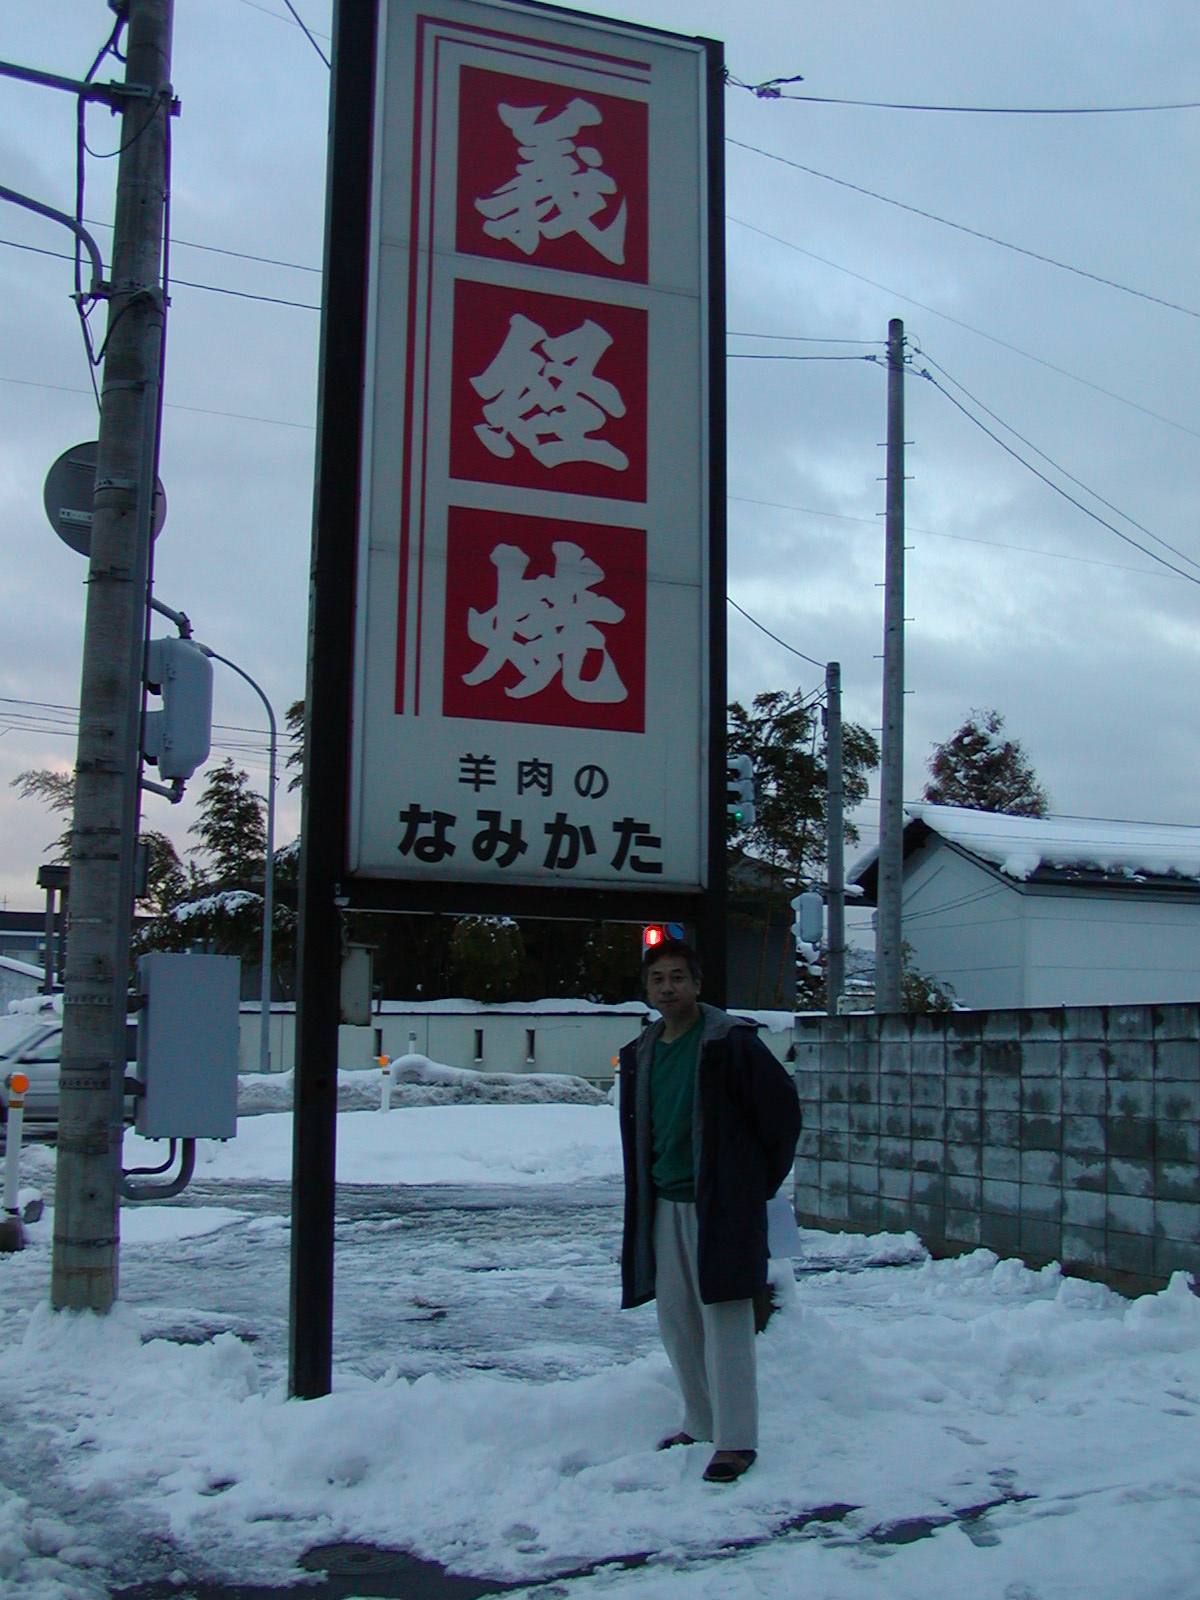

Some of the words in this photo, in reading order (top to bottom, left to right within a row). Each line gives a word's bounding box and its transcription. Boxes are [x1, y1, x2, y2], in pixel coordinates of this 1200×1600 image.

[461, 97, 629, 704] 義経焼
[458, 753, 610, 799] 羊肉の
[397, 803, 663, 874] なみかた
